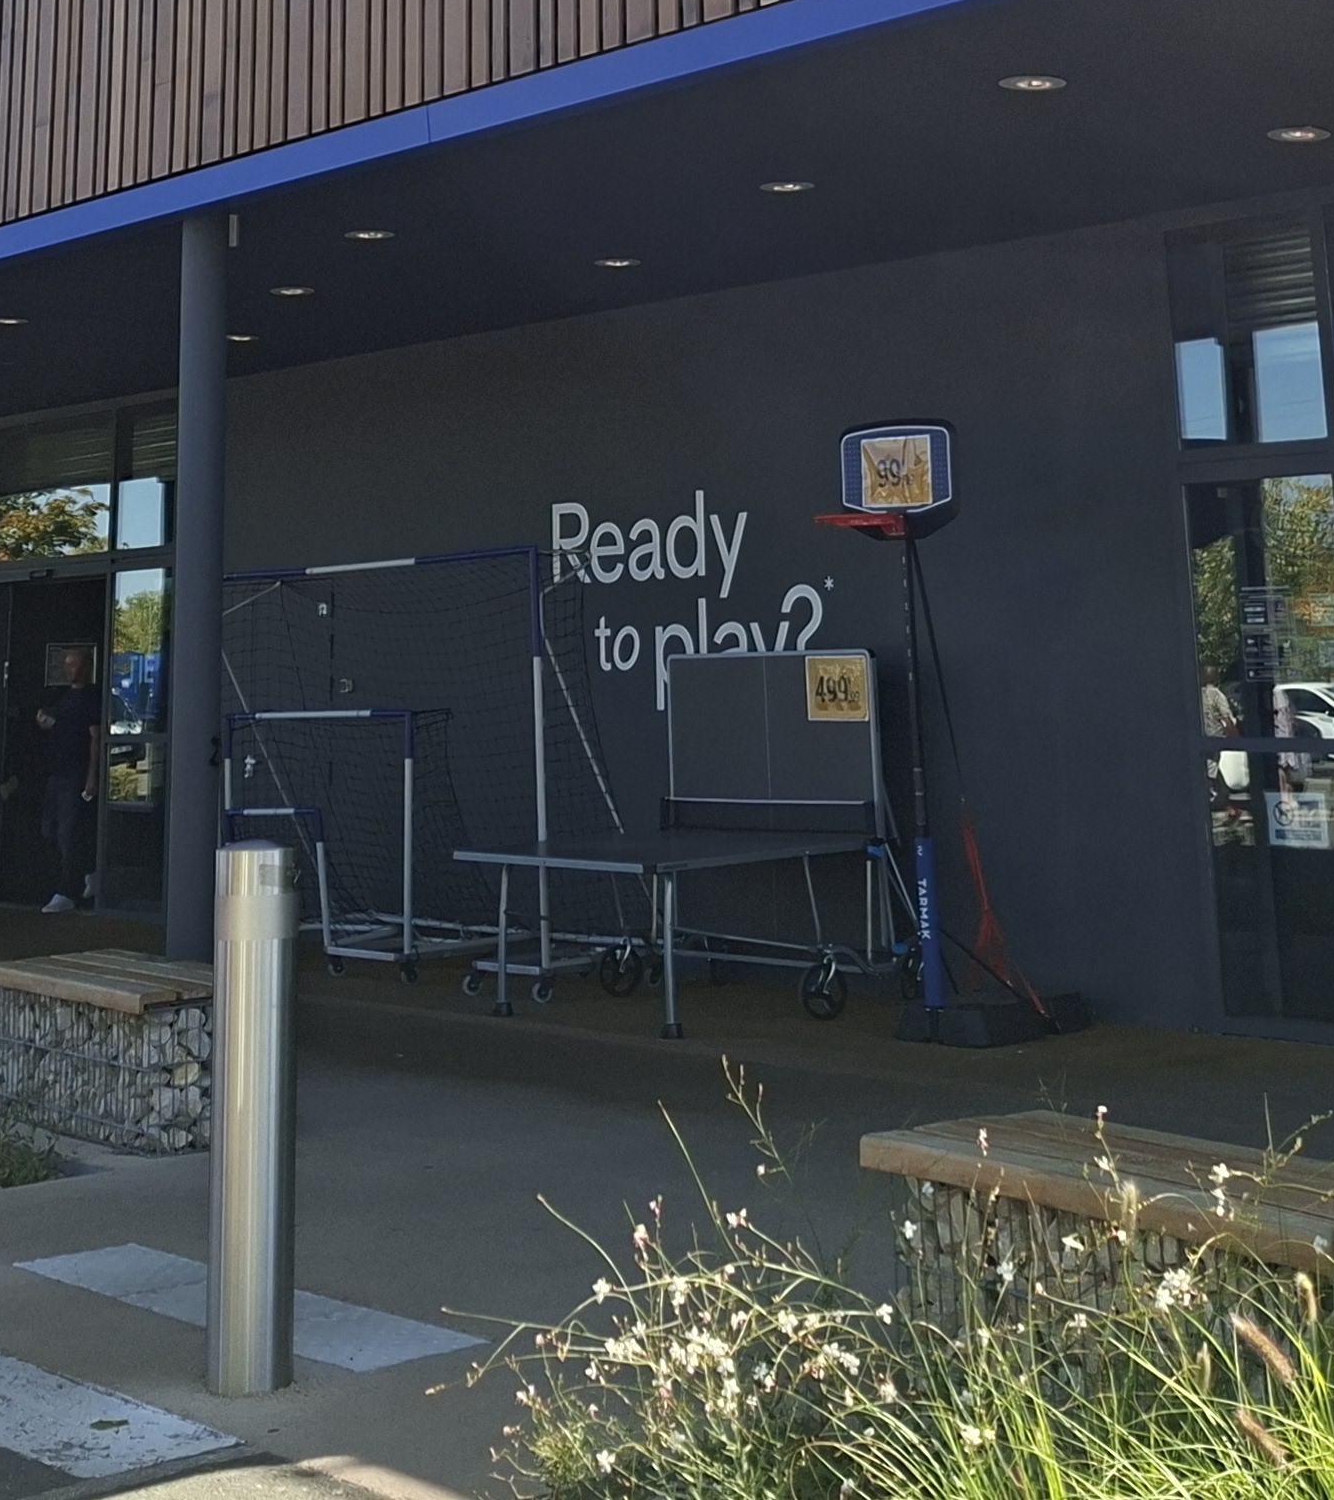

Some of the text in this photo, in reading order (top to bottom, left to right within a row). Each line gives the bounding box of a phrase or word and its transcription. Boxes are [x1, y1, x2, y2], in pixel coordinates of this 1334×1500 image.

[552, 489, 747, 598] Ready
[594, 615, 640, 671] to
[917, 878, 931, 940] TARMAK
